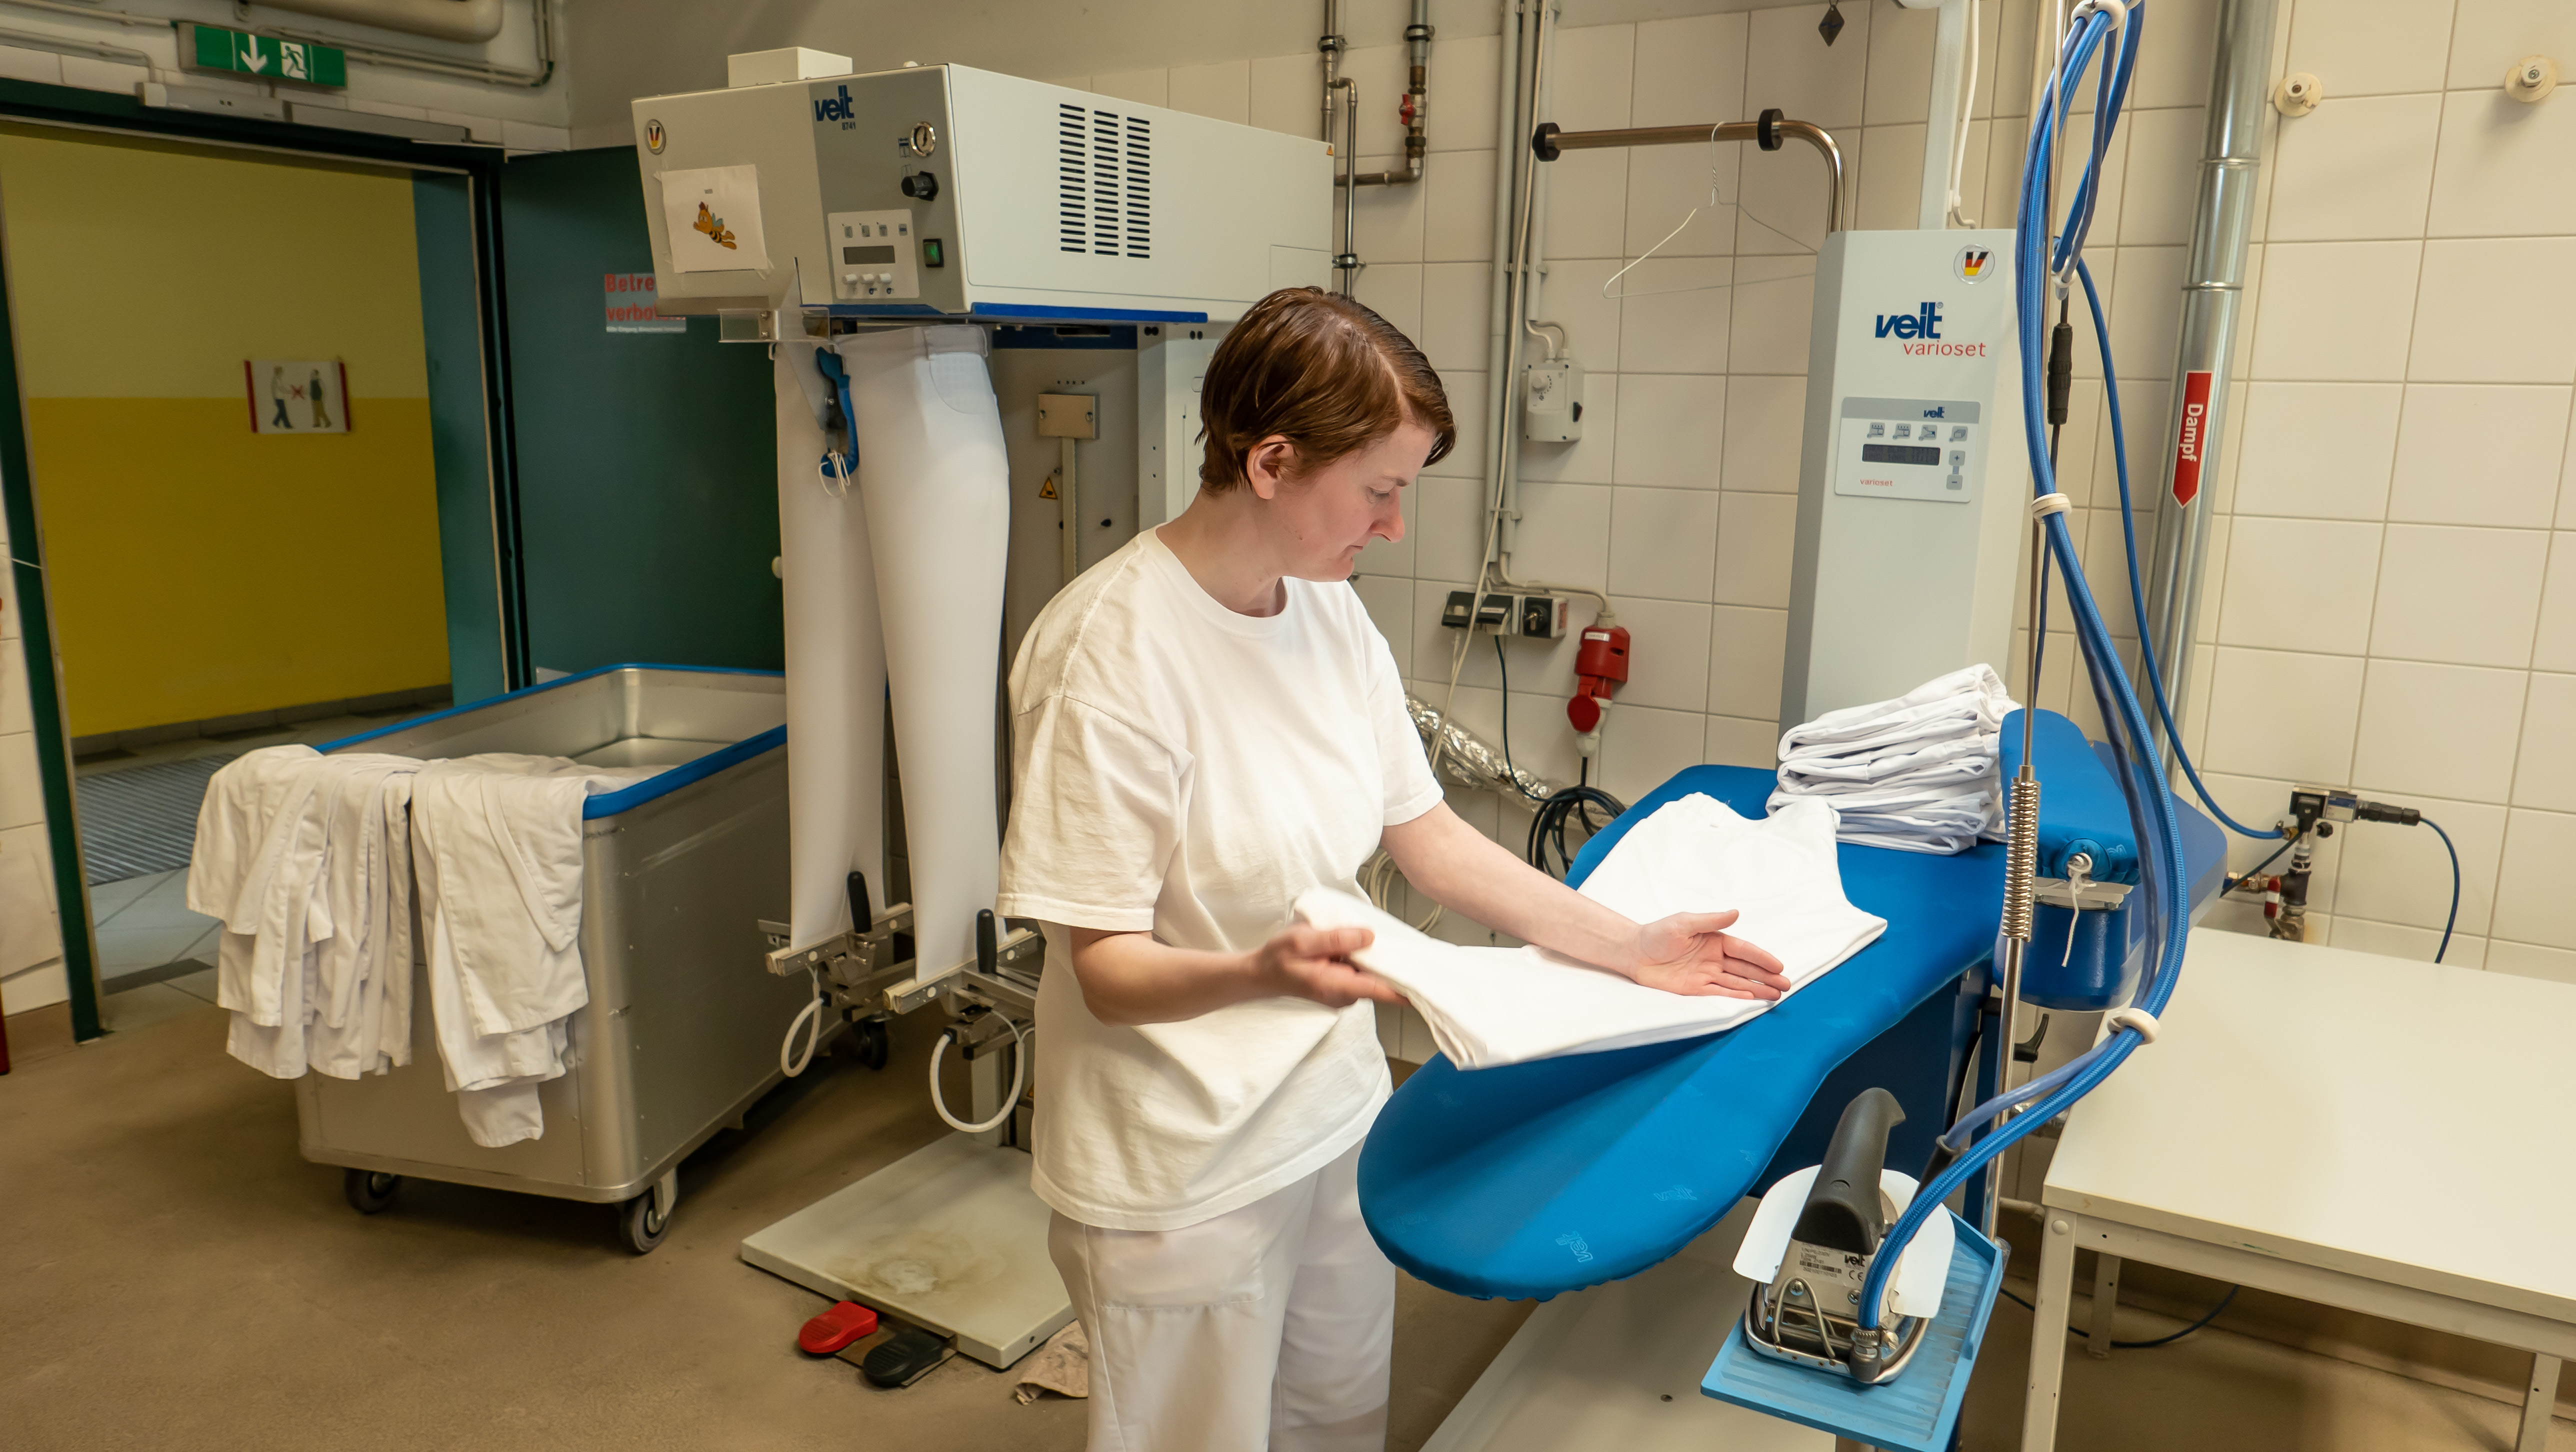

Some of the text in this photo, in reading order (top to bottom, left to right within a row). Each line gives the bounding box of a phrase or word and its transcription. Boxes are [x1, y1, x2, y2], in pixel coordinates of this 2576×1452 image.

[814, 84, 854, 122] veit
[605, 274, 654, 292] Betre
[1903, 340, 1986, 357] varioset
[1924, 406, 1945, 418] veit
[2180, 403, 2204, 462] Dampf
[1860, 478, 1893, 487] varioset
